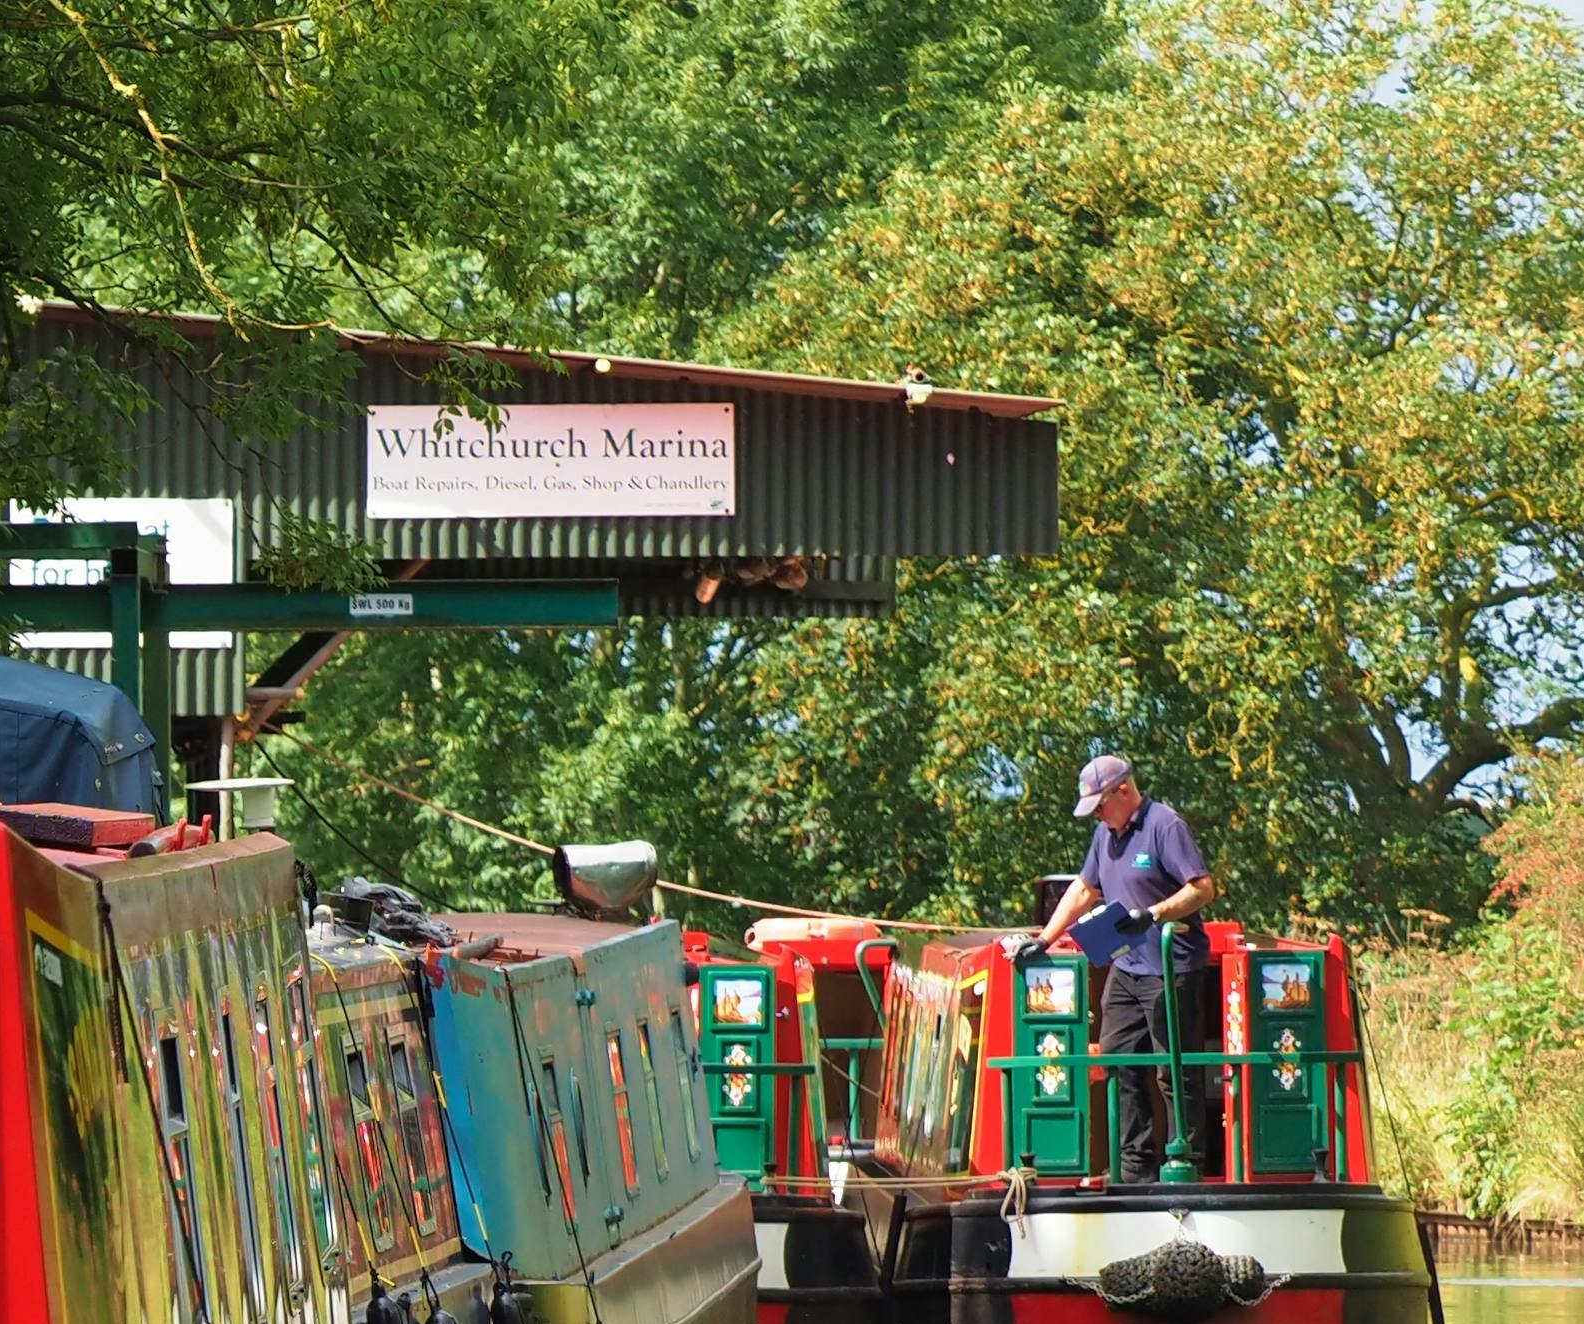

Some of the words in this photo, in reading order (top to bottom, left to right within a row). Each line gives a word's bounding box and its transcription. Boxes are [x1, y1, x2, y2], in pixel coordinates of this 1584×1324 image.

[375, 427, 588, 459] Whitchurch
[601, 428, 730, 459] Marina
[371, 475, 409, 491] Boat
[485, 475, 537, 491] Diesel,
[543, 475, 577, 491] Gas,
[582, 475, 623, 492] Shop
[627, 474, 643, 490] &
[645, 474, 728, 492] Chandlery
[352, 599, 373, 610] SWL
[376, 599, 395, 610] 500
